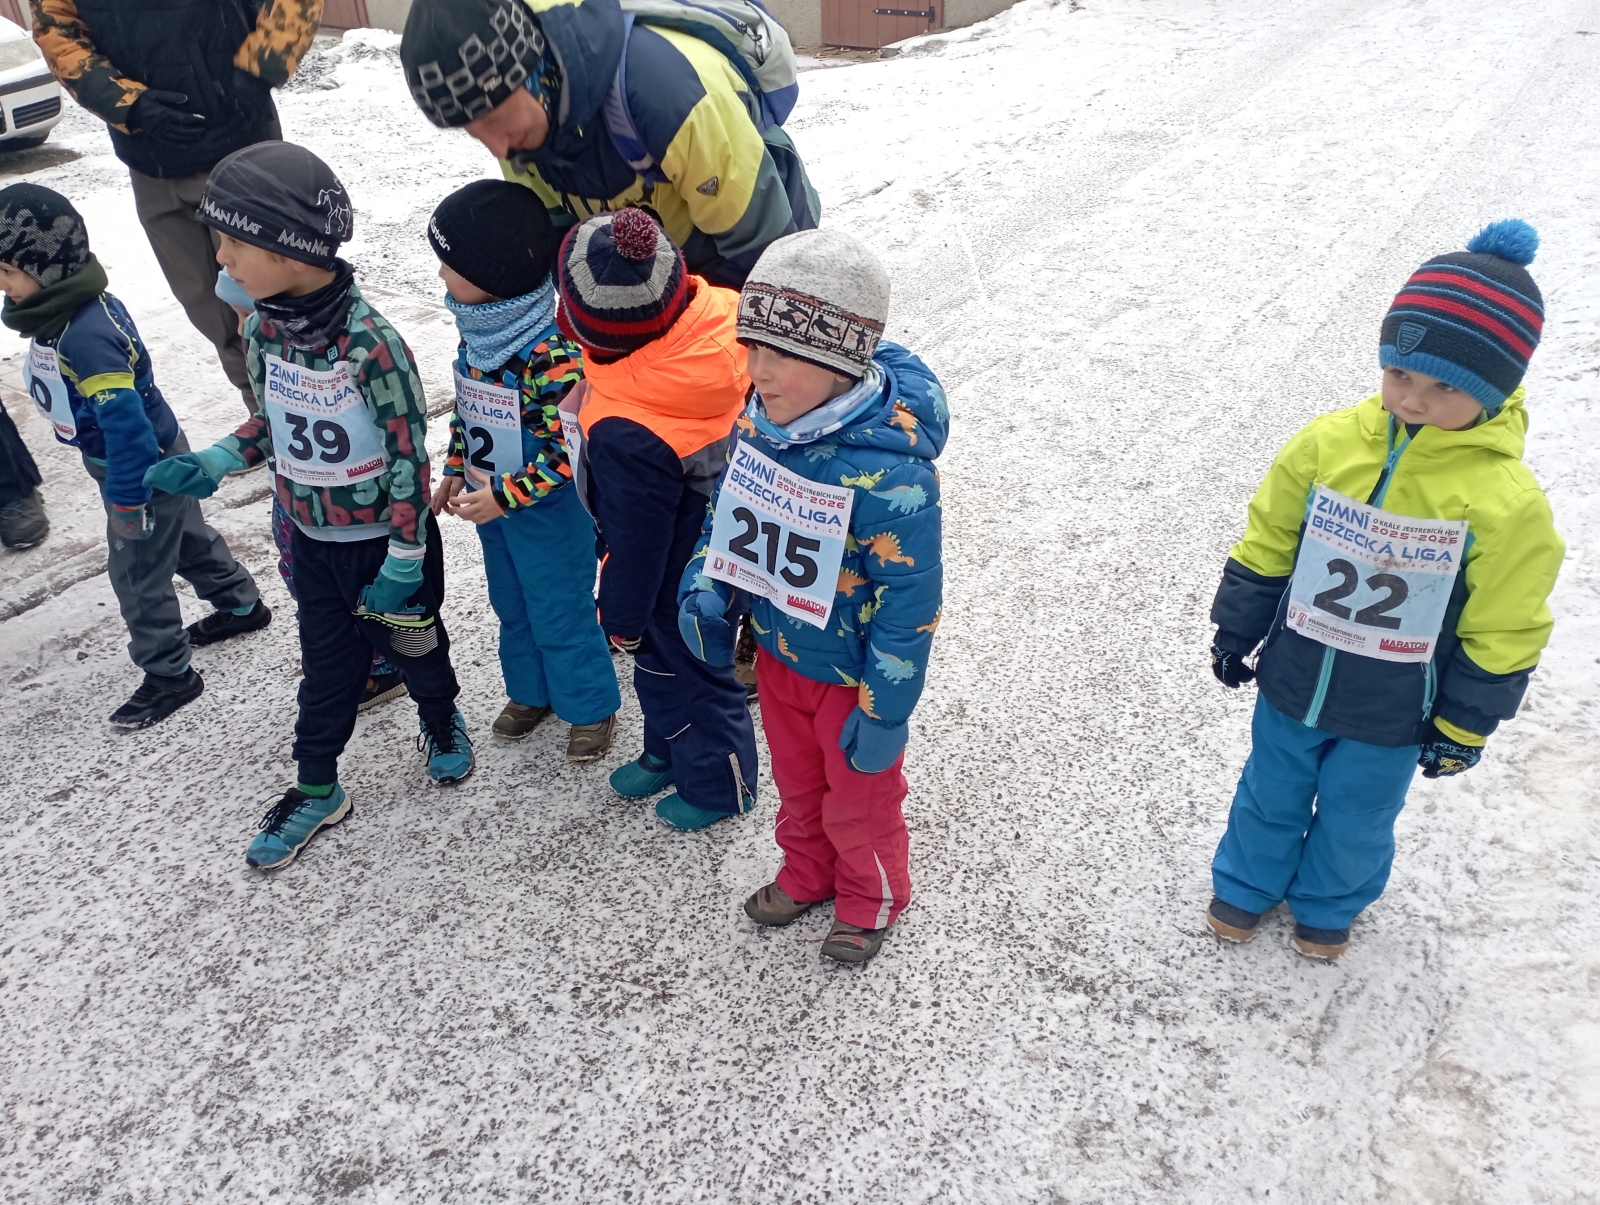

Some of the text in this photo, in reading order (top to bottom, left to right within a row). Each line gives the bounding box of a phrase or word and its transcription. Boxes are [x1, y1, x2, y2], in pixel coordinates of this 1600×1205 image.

[462, 389, 515, 407] 2025-2026
[482, 405, 516, 421] LIGA
[284, 411, 351, 464] 39
[346, 457, 384, 474] MARATON
[735, 448, 778, 487] ZIMNÍ
[730, 468, 843, 528] BĚŽECKÁ LIGA
[776, 480, 846, 510] 2025-2026
[782, 476, 797, 489] KRÁLE
[797, 483, 832, 499] JESTŘEBÍCH
[832, 494, 847, 503] HOR
[1316, 494, 1371, 530] ZIMNÍ
[1312, 514, 1453, 563] BĚŽECKÁ LIGA
[1371, 524, 1458, 545] 2025-2026
[1379, 519, 1401, 531] KRÁLE
[1401, 525, 1444, 535] JESTŘEBÍCH
[1444, 529, 1460, 537] HOR
[728, 506, 821, 589] 215
[787, 593, 828, 614] MARATON
[1312, 558, 1409, 631] 22
[1379, 638, 1429, 651] MARATON
